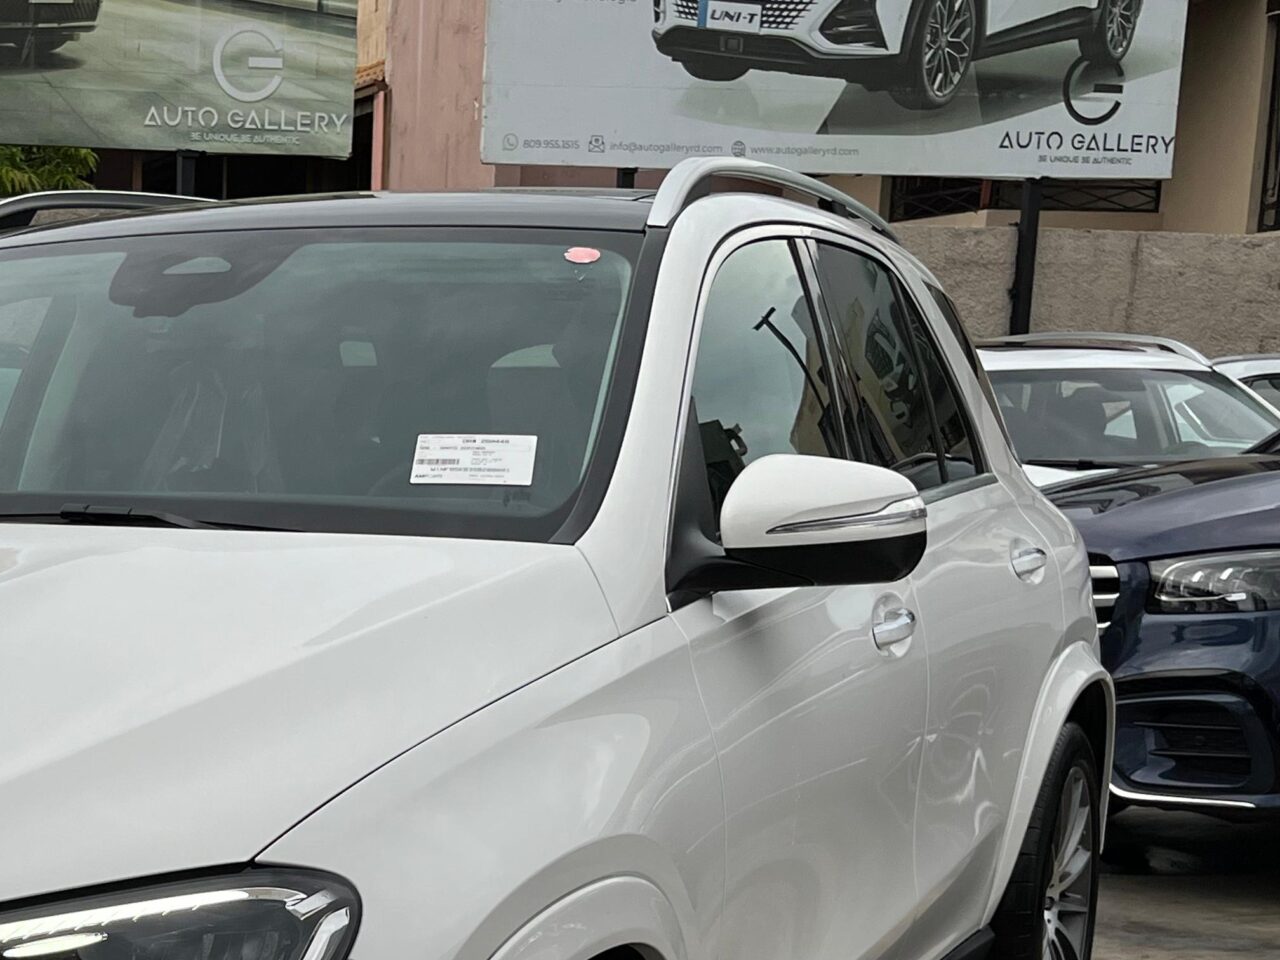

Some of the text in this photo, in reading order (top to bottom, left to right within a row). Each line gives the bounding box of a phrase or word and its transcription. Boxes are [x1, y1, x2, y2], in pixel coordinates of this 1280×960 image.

[710, 9, 758, 24] UNI-T
[144, 105, 347, 133] AUTO GALLERY
[610, 141, 723, 154] info@autogalleryrd.com
[750, 145, 859, 157] www.autogalleryrd.com
[999, 131, 1175, 154] AUTO GALLERY
